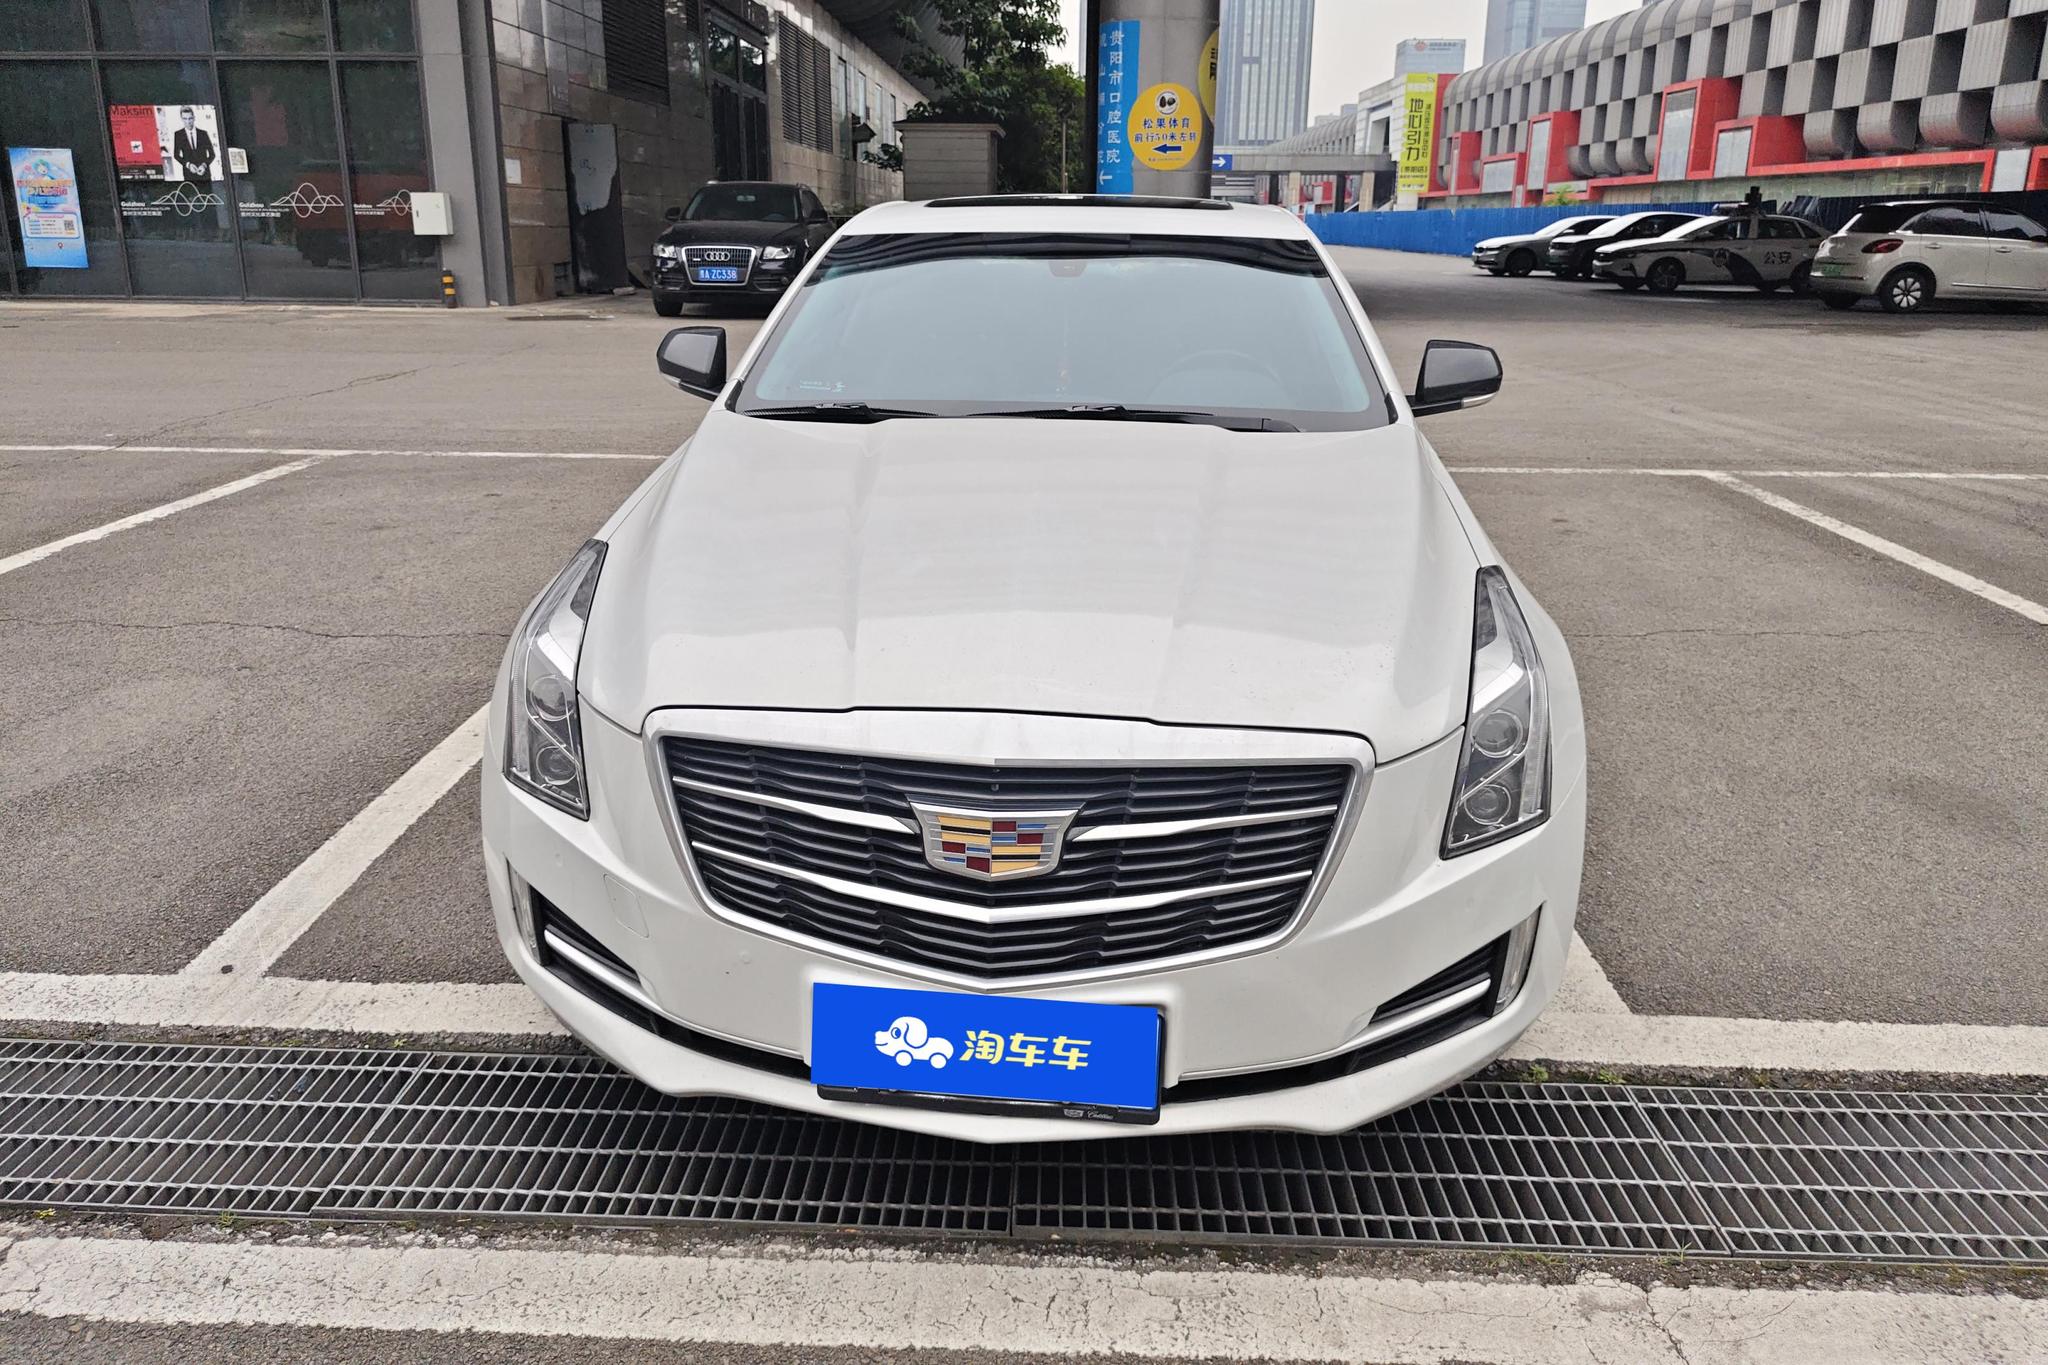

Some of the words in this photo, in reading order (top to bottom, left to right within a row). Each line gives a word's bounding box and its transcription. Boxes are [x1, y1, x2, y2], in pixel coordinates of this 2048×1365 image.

[1106, 30, 1125, 163] 贵阳市口腔医院
[112, 105, 153, 117] Maksim
[1143, 117, 1190, 129] 松果体育
[1406, 98, 1424, 161] 地心引力
[1764, 251, 1791, 264] 公安
